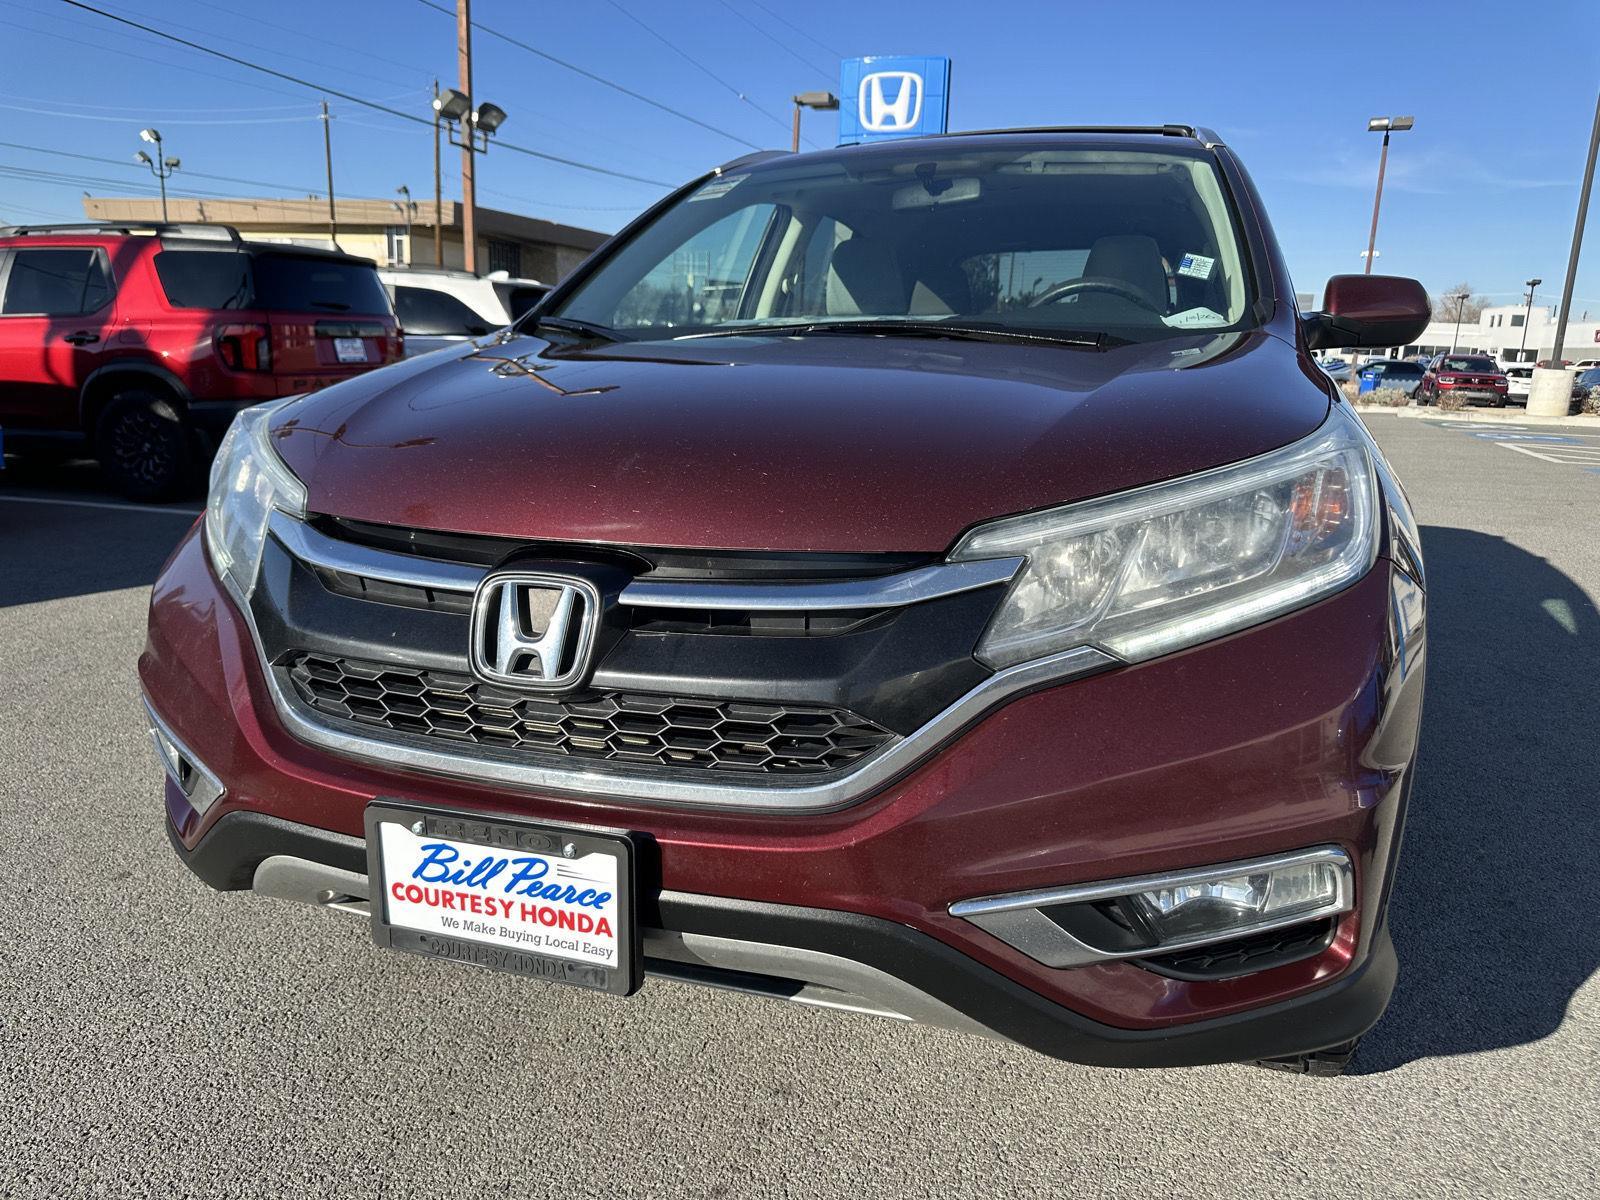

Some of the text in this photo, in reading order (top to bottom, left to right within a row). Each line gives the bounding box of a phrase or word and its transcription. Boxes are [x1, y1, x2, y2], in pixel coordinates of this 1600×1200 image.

[412, 843, 612, 909] Bill Pearce
[391, 882, 613, 938] COURTESY HONDA
[431, 938, 568, 980] COURTESY HONDA
[441, 916, 613, 960] We Make Buying Local Easy
